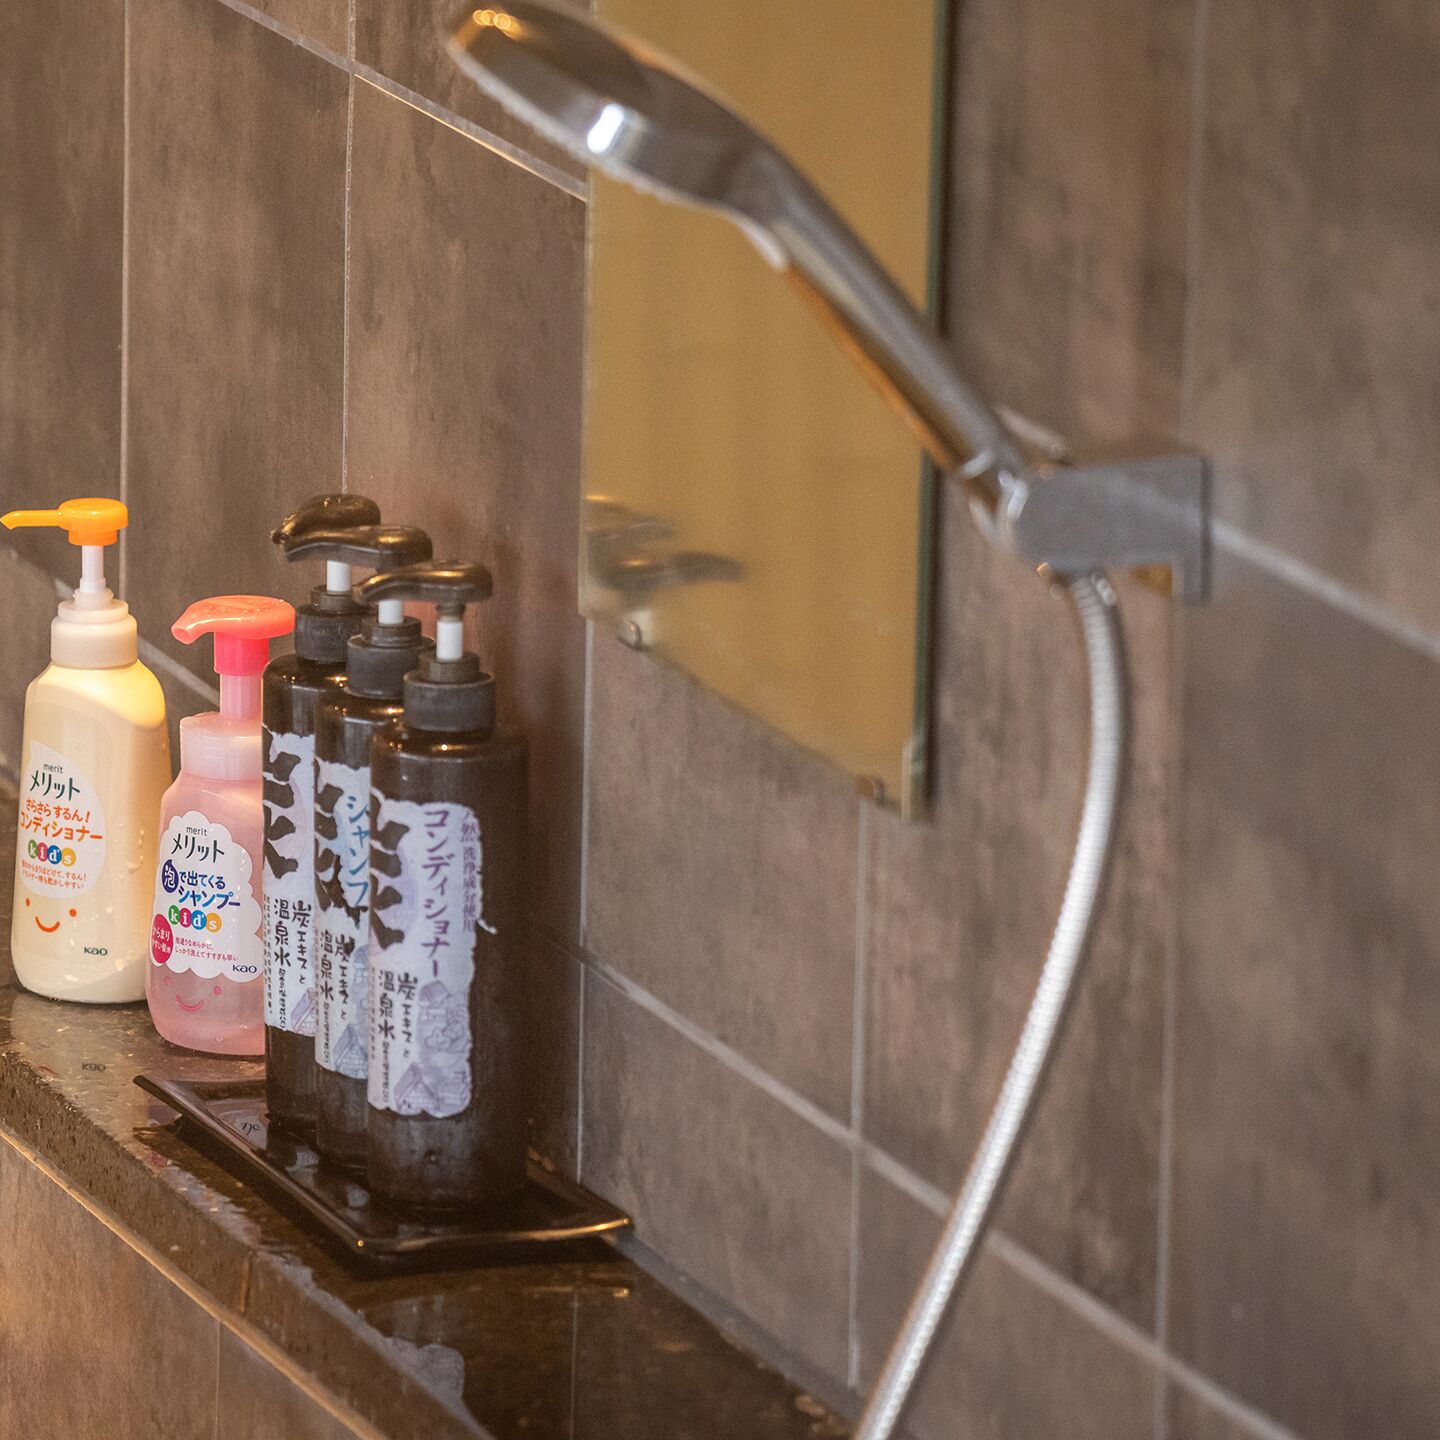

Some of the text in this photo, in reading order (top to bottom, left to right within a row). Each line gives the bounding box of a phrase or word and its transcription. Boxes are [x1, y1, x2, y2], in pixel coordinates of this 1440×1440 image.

[43, 763, 63, 774] merit
[29, 770, 80, 801] メリット
[20, 811, 103, 842] コンディショナー
[186, 826, 207, 836] merit
[171, 833, 225, 863] メリット
[163, 864, 226, 890] 泡で出てくる
[178, 886, 240, 909] シャンプー
[421, 810, 455, 977] コンディショナー
[274, 898, 291, 967] 温泉水
[291, 899, 312, 985] 炭エキスと
[320, 929, 334, 1001] 温泉水
[378, 970, 395, 1040] 温泉水
[397, 972, 418, 1059] 炭エキスと
